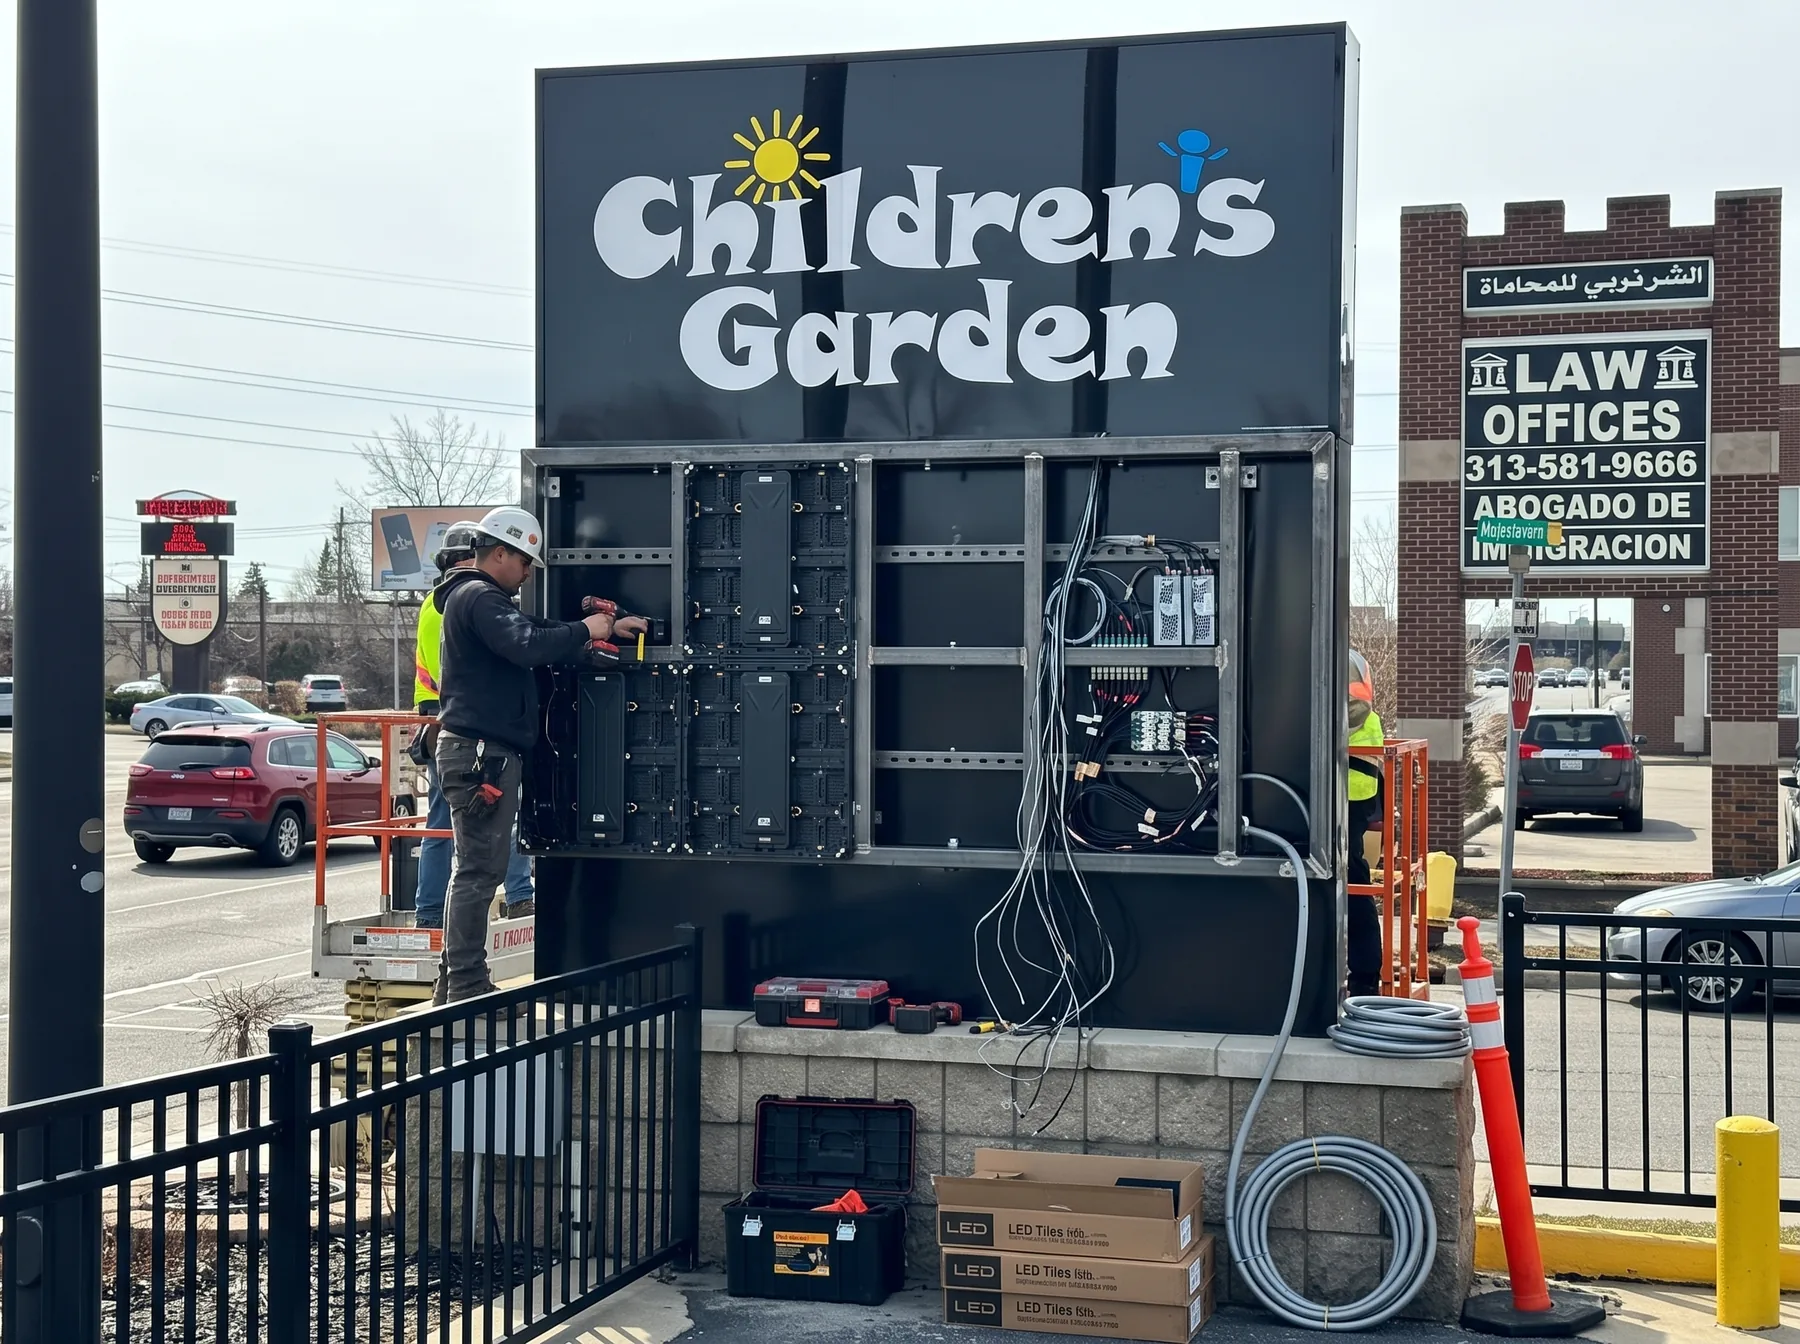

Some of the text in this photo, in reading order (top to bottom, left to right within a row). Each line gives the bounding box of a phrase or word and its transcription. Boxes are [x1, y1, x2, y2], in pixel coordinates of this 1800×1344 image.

[593, 162, 1276, 280] Children's
[1479, 273, 1577, 296] للمحاماة
[680, 278, 1179, 392] Garden
[1515, 349, 1648, 393] LAW
[1482, 399, 1681, 445] OFFICES
[1465, 449, 1698, 482] 313-581-9666
[1473, 491, 1691, 520] ABOGADO DE
[1471, 533, 1691, 561] IMIGRACION
[1511, 671, 1533, 702] STOP
[946, 1220, 987, 1235] LED
[1008, 1223, 1033, 1236] LED
[1036, 1225, 1064, 1238] Tiles
[953, 1263, 995, 1278] LED
[1015, 1263, 1040, 1276] LED
[1043, 1265, 1071, 1279] Tiles
[954, 1299, 996, 1315] LED
[1016, 1301, 1041, 1314] LED
[1043, 1303, 1073, 1317] Tiles
